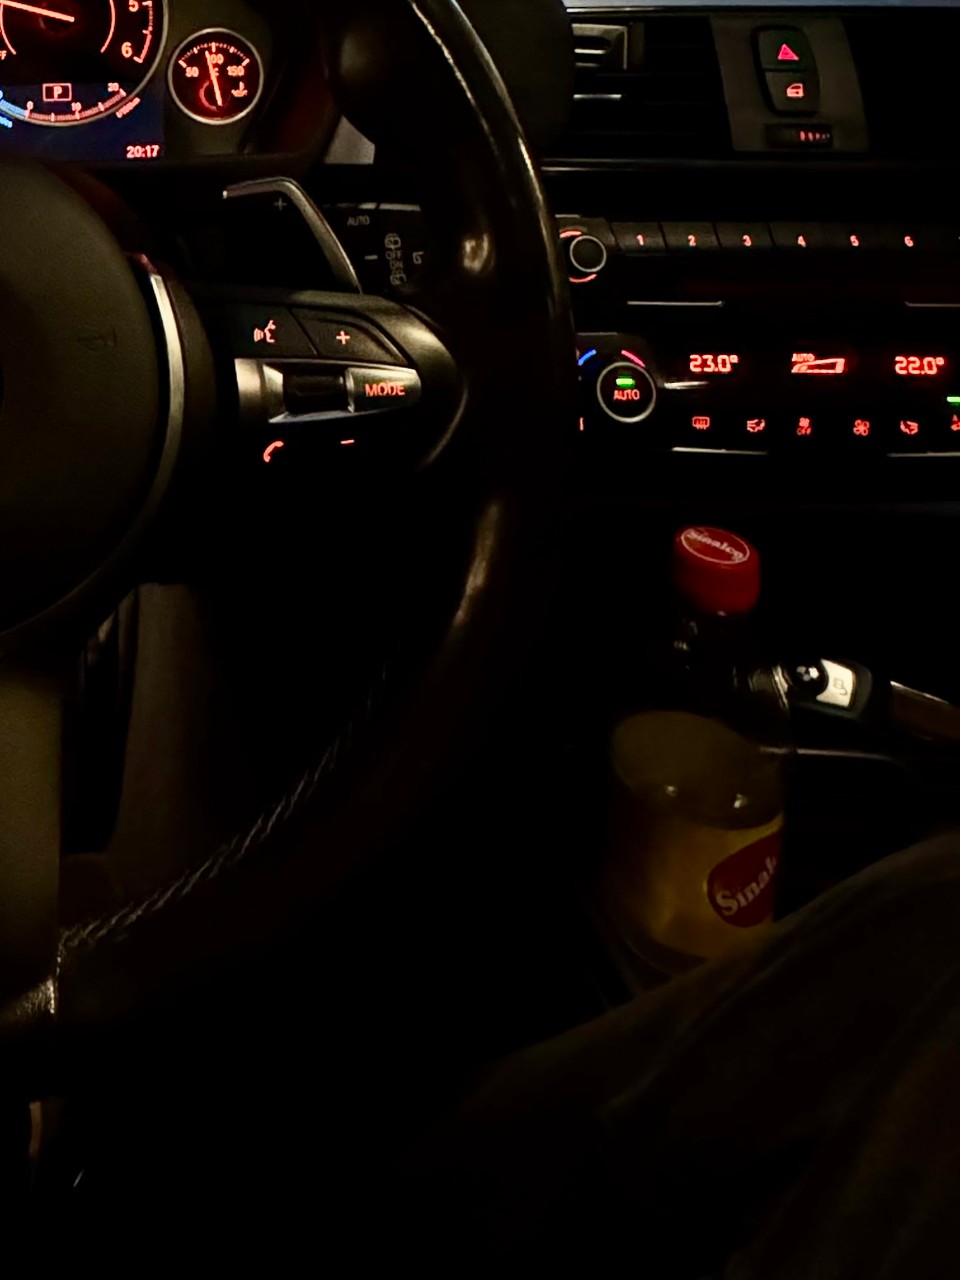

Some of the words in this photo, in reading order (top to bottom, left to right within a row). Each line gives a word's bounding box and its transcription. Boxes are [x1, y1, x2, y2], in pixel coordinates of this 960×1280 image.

[121, 41, 132, 58] 6
[185, 66, 199, 78] 50
[53, 86, 63, 99] P
[126, 144, 160, 158] 20:17
[636, 234, 644, 246] 1
[688, 234, 697, 247] 2
[742, 234, 752, 247] 3
[797, 234, 807, 248] 4
[850, 234, 859, 247] 5
[904, 235, 914, 248] 6
[791, 353, 815, 362] AUTO
[365, 382, 406, 397] MODE
[613, 389, 640, 401] AUTO
